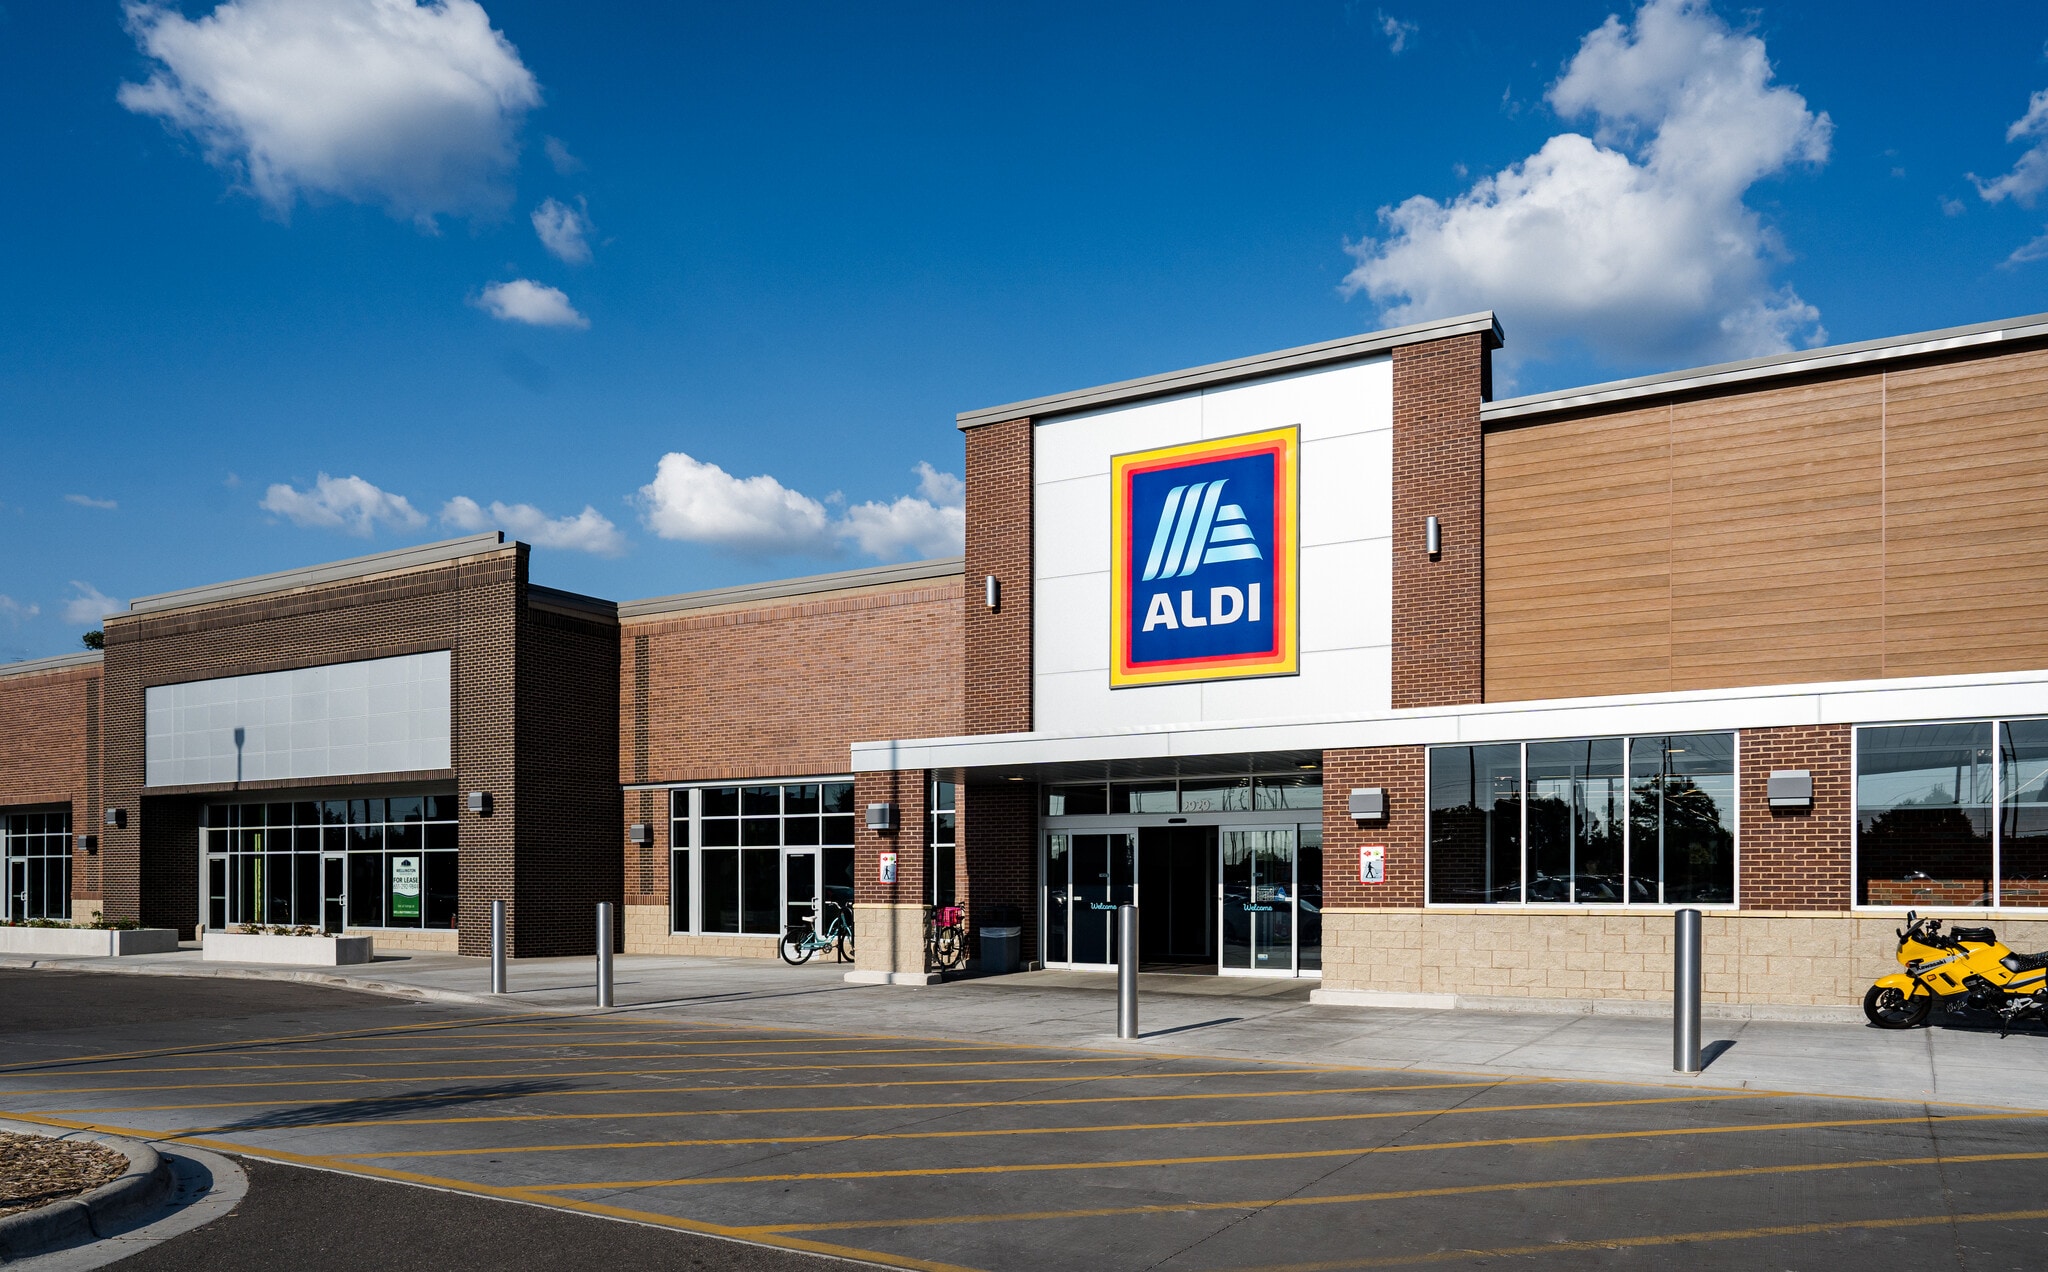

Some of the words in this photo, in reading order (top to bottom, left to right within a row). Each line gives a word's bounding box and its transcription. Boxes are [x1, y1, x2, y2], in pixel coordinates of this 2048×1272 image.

[1142, 582, 1261, 632] ALDI
[1090, 902, 1117, 910] Welcome
[1243, 903, 1273, 911] Welcome
[1917, 959, 1946, 970] Kawasaki
